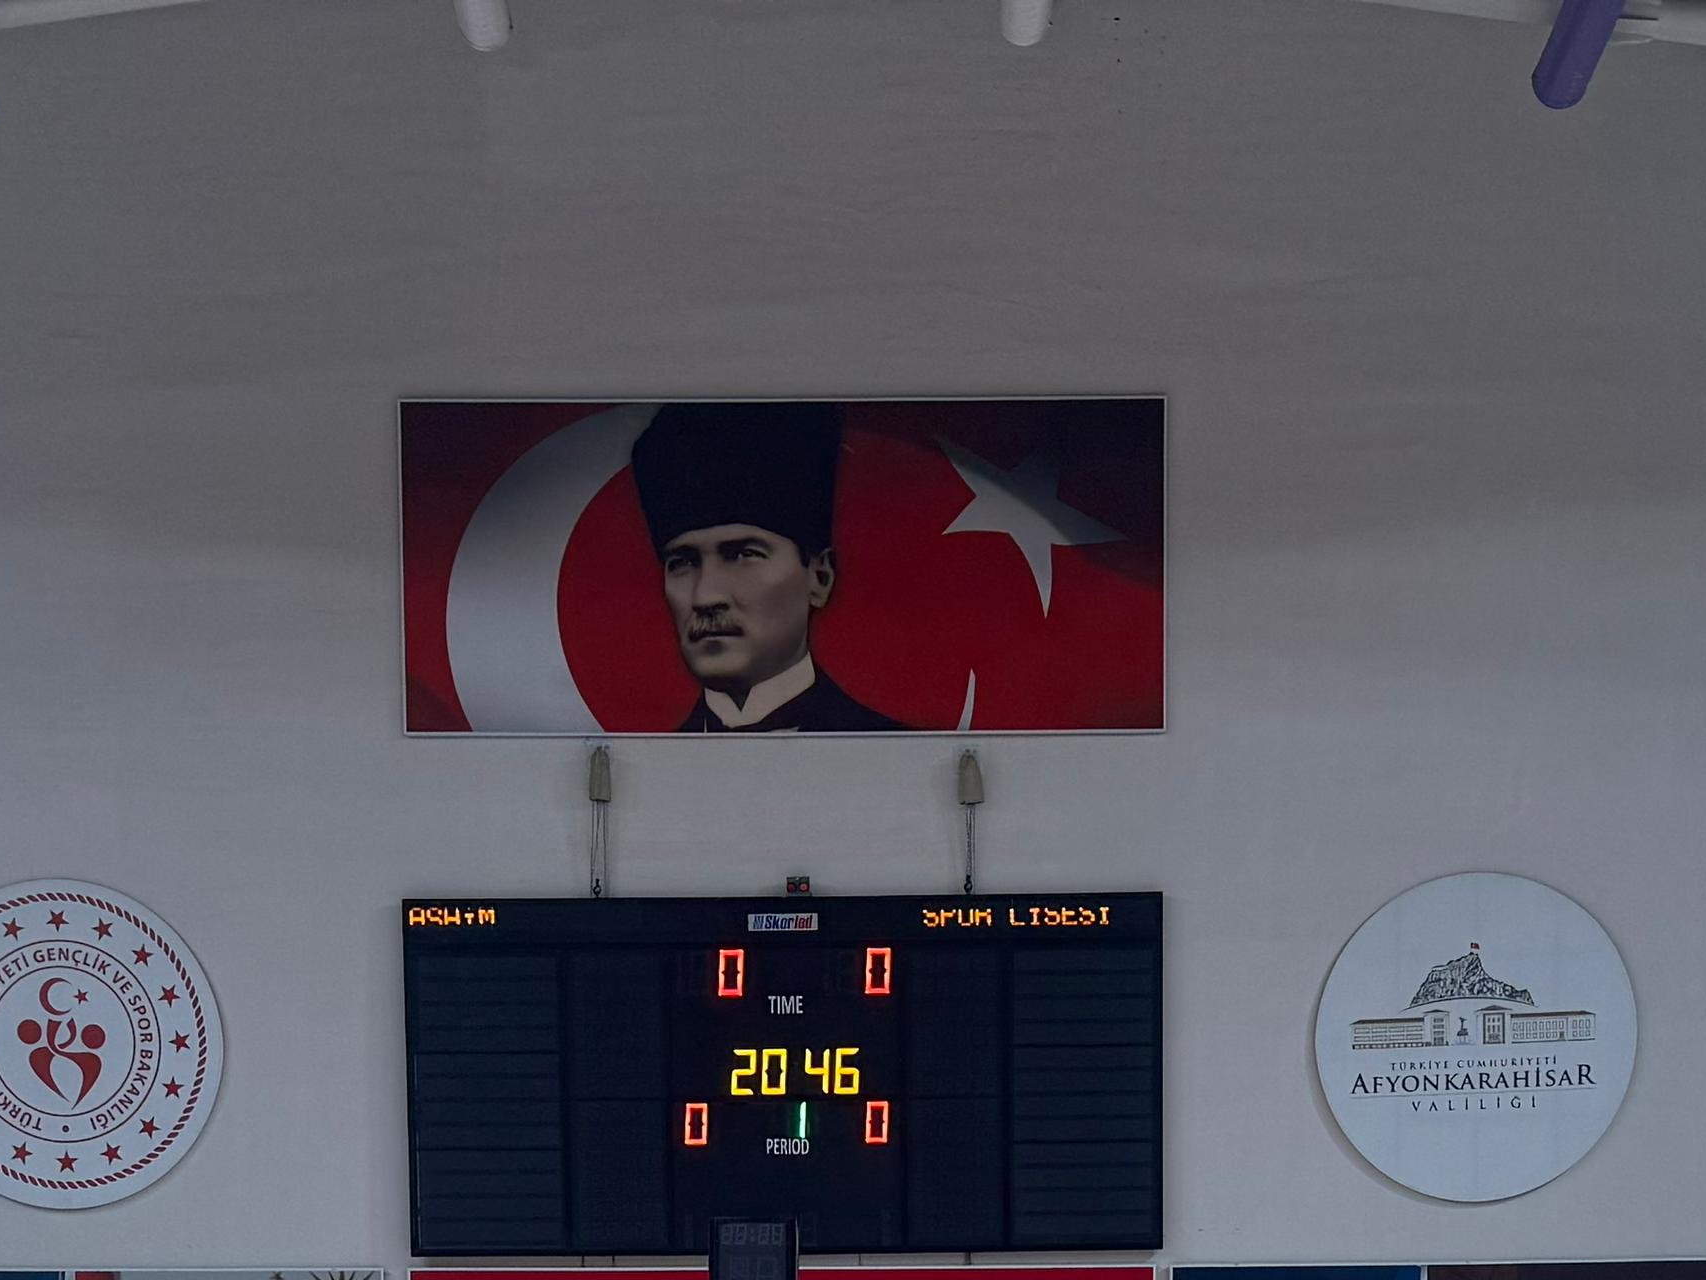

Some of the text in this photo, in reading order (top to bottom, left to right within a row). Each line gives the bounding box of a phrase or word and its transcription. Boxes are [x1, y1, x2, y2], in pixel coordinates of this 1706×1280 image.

[33, 947, 111, 975] GENÇLİK
[718, 949, 744, 996] 0
[865, 948, 891, 994] 0
[112, 970, 133, 995] VE
[127, 994, 154, 1043] SPOR
[768, 996, 804, 1014] TIME
[731, 1048, 860, 1095] 20 46
[1351, 1063, 1596, 1095] AFYONKARAHİSAR
[1391, 1059, 1449, 1071] TÜRKİYE
[90, 1050, 154, 1131] BAKANLIĞI
[1412, 1095, 1537, 1112] VALİLİĞİ
[684, 1103, 708, 1145] 0
[799, 1101, 807, 1138] 1
[865, 1101, 889, 1143] 0
[766, 1138, 810, 1155] PERIOD
